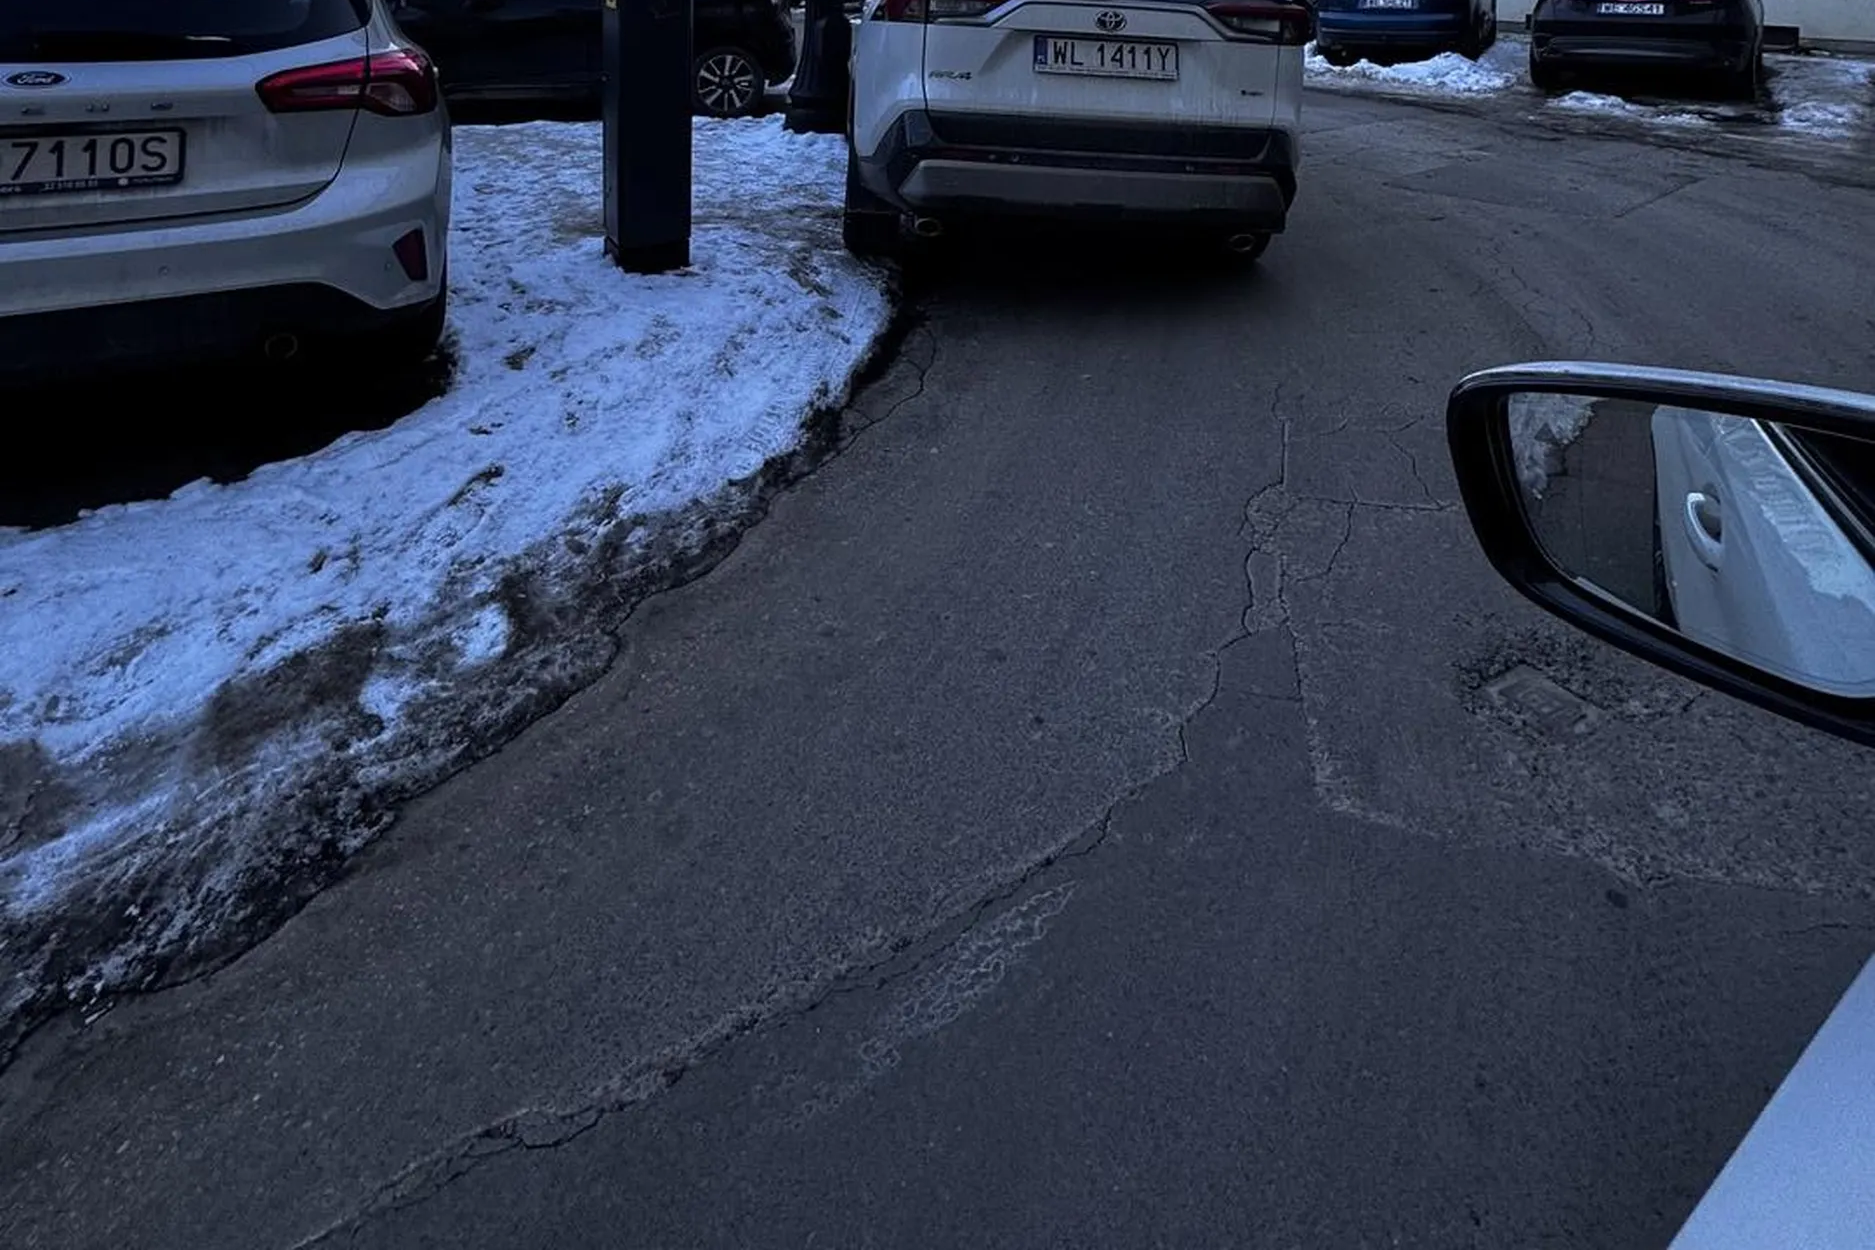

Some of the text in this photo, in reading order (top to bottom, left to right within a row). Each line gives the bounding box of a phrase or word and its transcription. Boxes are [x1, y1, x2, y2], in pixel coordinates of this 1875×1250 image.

[1053, 41, 1170, 71] WL 1411Y
[16, 72, 55, 85] Ford
[11, 136, 167, 181] 7110S
